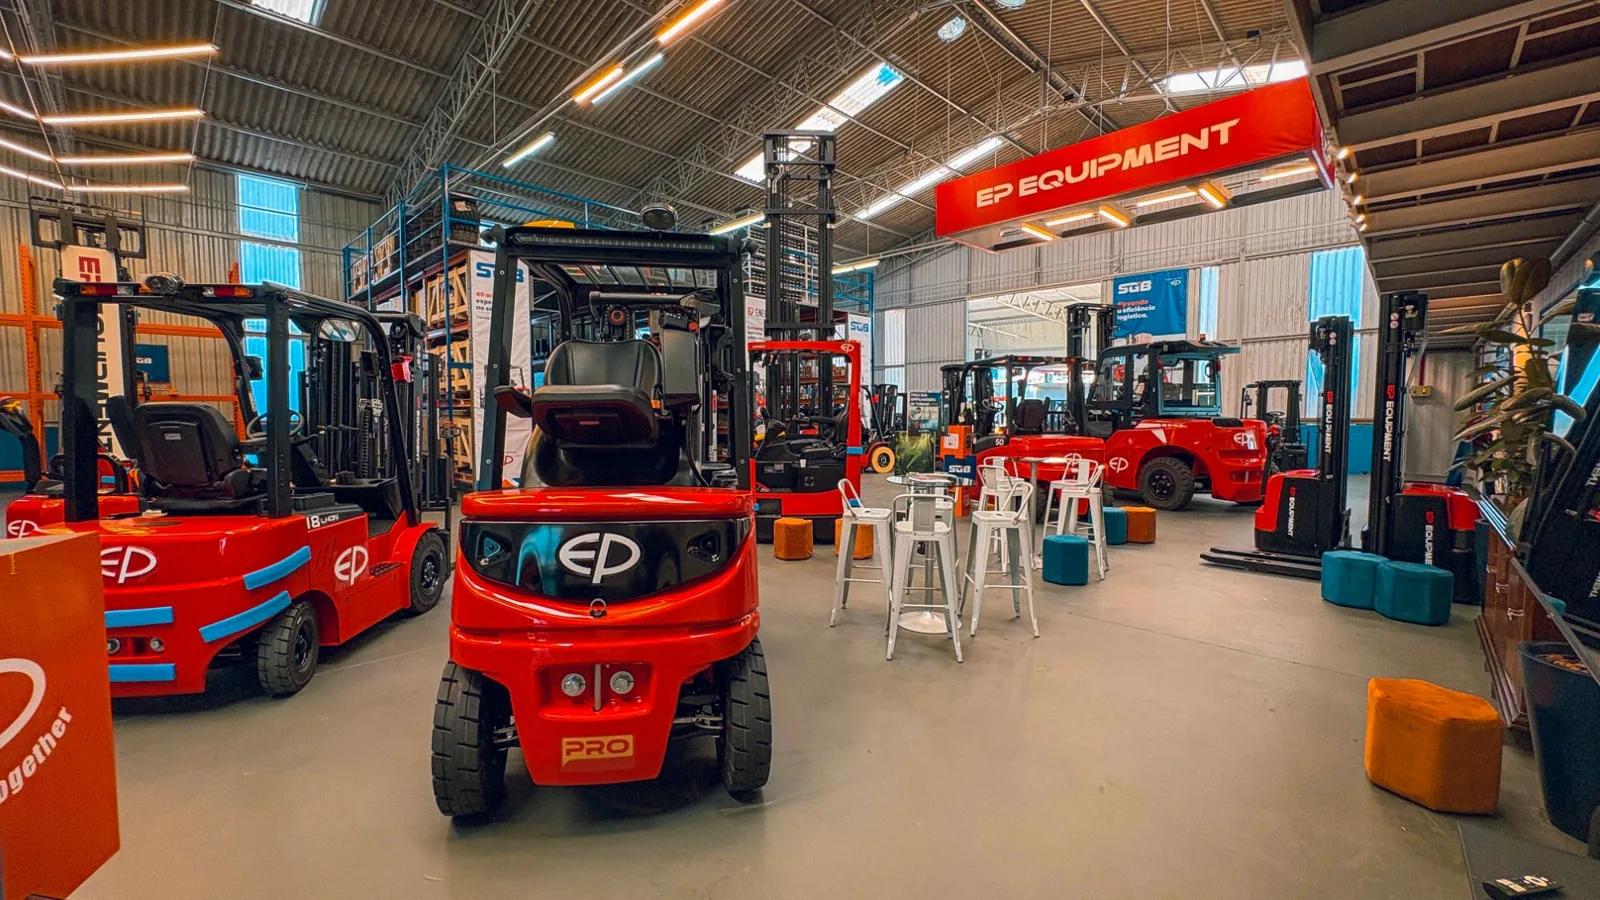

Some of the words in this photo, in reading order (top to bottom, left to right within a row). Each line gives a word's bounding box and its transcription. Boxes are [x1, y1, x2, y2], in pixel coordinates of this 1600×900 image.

[976, 182, 1014, 208] EP
[1018, 118, 1240, 197] EQUIPMENT
[1118, 280, 1152, 295] SGB
[850, 321, 869, 333] SGB
[1324, 403, 1333, 454] EQUIPMENT
[1383, 400, 1395, 462] EQUIPMENT
[948, 465, 971, 473] SGB
[1109, 457, 1129, 473] EP
[1287, 497, 1296, 537] EQUIPMENT
[559, 532, 641, 584] EP
[1425, 524, 1434, 565] EQUIPME
[101, 546, 157, 584] EP
[334, 545, 369, 586] EP
[0, 706, 72, 804] ogether
[565, 739, 631, 756] PRO
